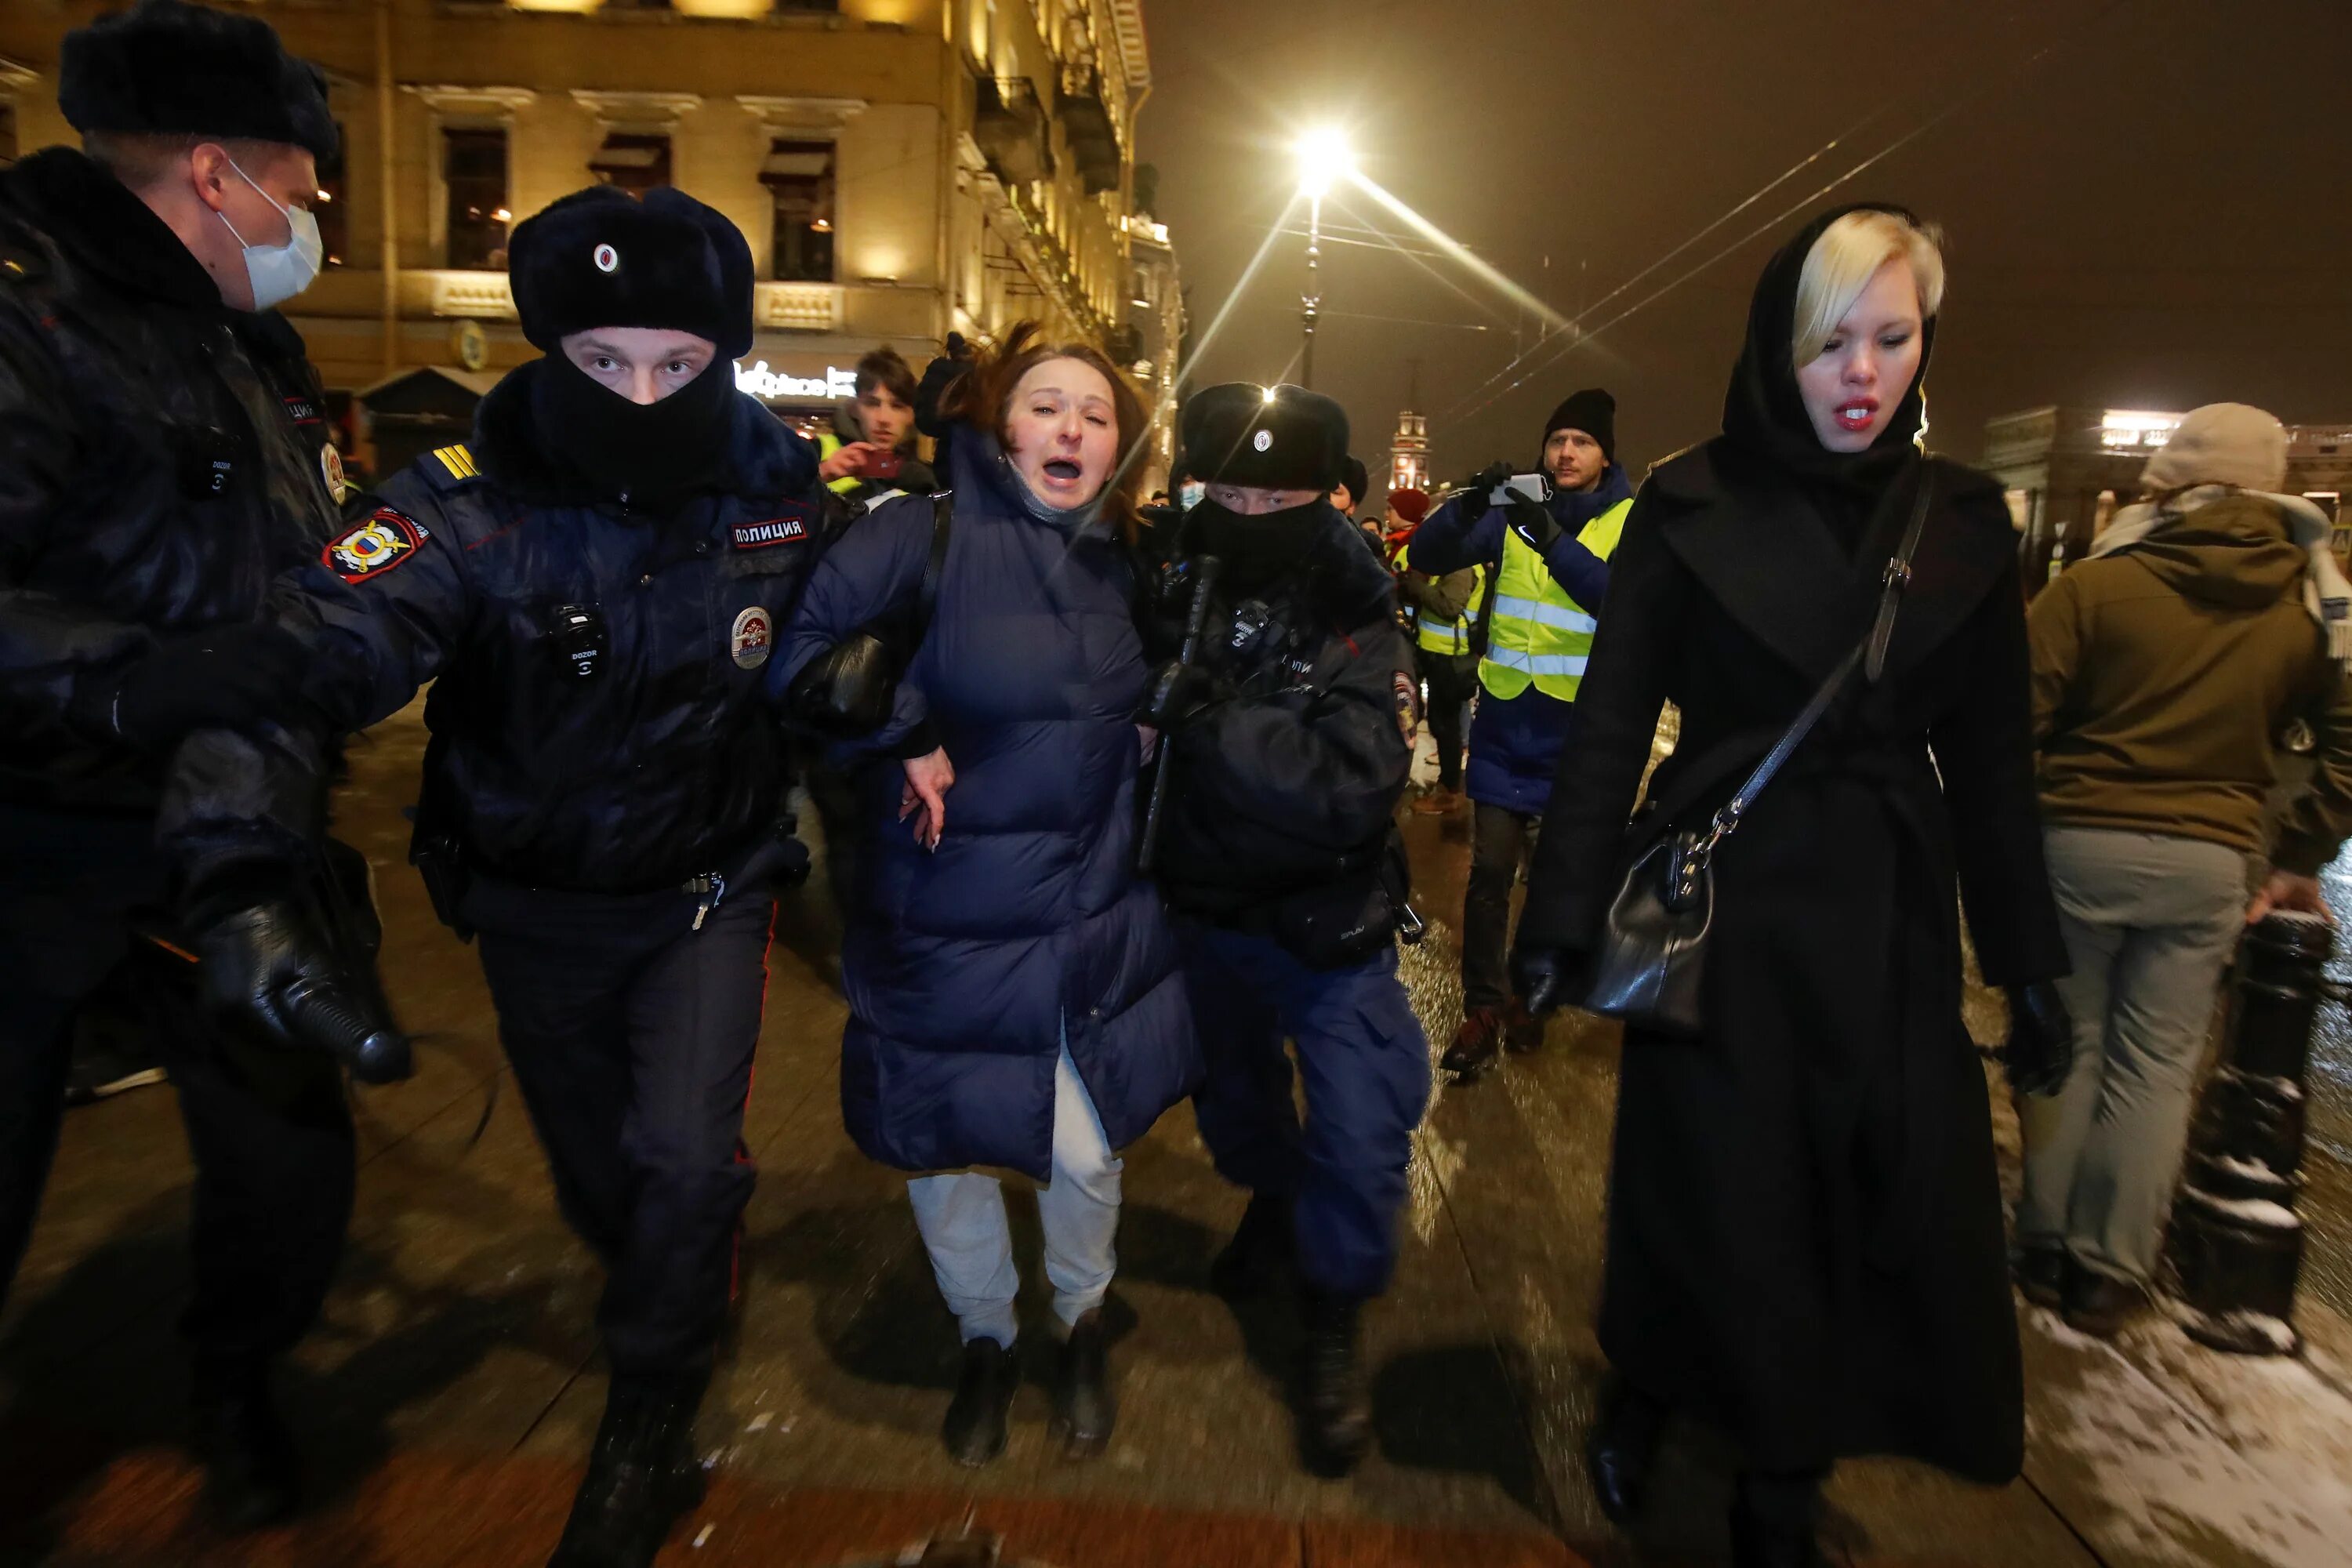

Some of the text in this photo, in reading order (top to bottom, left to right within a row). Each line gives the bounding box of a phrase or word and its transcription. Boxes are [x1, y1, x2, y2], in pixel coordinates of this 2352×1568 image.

[212, 461, 230, 470] DOZOR
[735, 521, 802, 543] ПОЛИЦИЯ
[1235, 622, 1254, 636] DOZOR
[572, 650, 597, 659] DOZOR
